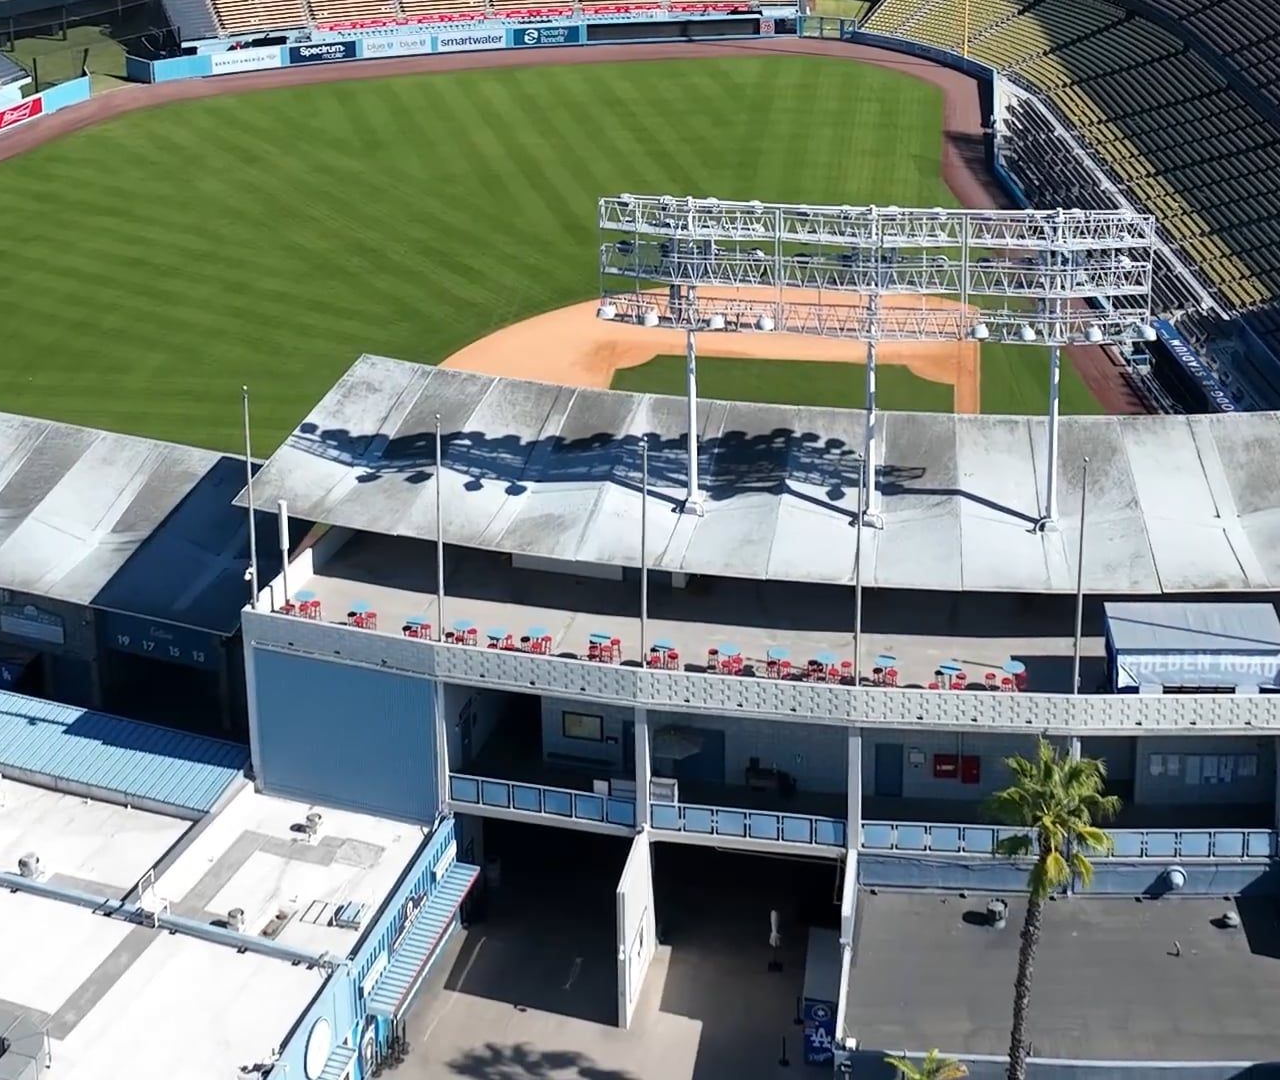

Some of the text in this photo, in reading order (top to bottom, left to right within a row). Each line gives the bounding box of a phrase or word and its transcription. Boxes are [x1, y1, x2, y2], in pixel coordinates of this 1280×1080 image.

[440, 35, 504, 47] smartwater
[299, 45, 342, 57] Spectrum
[116, 634, 205, 663] 19 17 15 13
